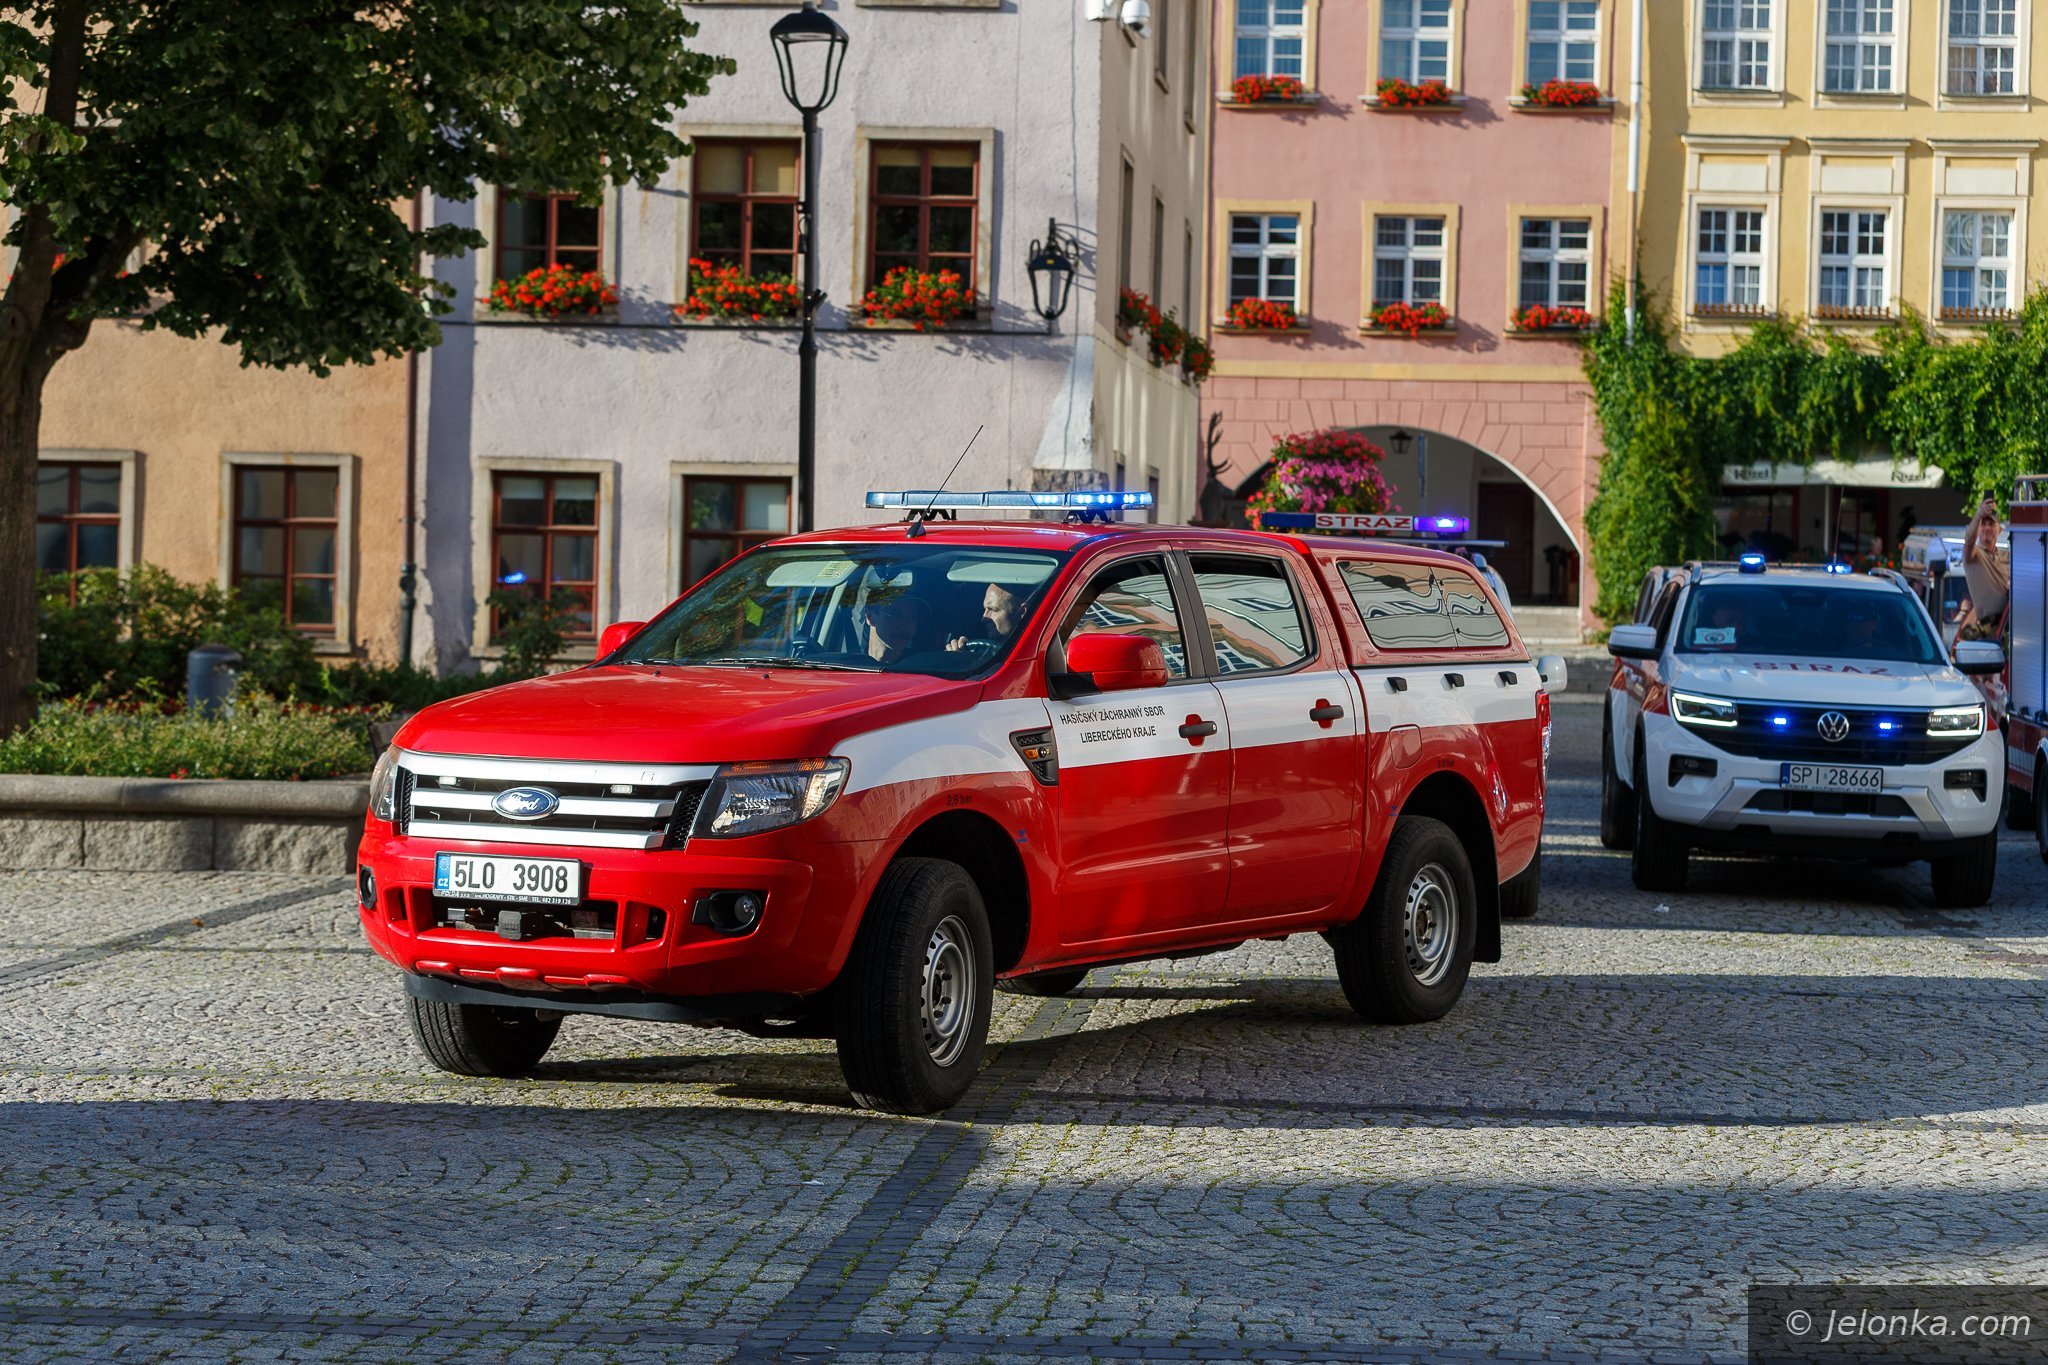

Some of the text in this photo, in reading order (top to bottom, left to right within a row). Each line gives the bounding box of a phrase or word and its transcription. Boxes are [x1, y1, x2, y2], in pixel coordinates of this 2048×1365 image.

[1059, 705, 1165, 725] HASIČSKÝ ZÁCHRANNÝ SBOR
[1080, 725, 1157, 743] LIBERECKÉHO KRAJE
[1791, 766, 1820, 784] SPI
[1828, 768, 1879, 787] 28666
[504, 791, 541, 811] Ford
[438, 878, 449, 887] CZ
[512, 863, 568, 893] 3908
